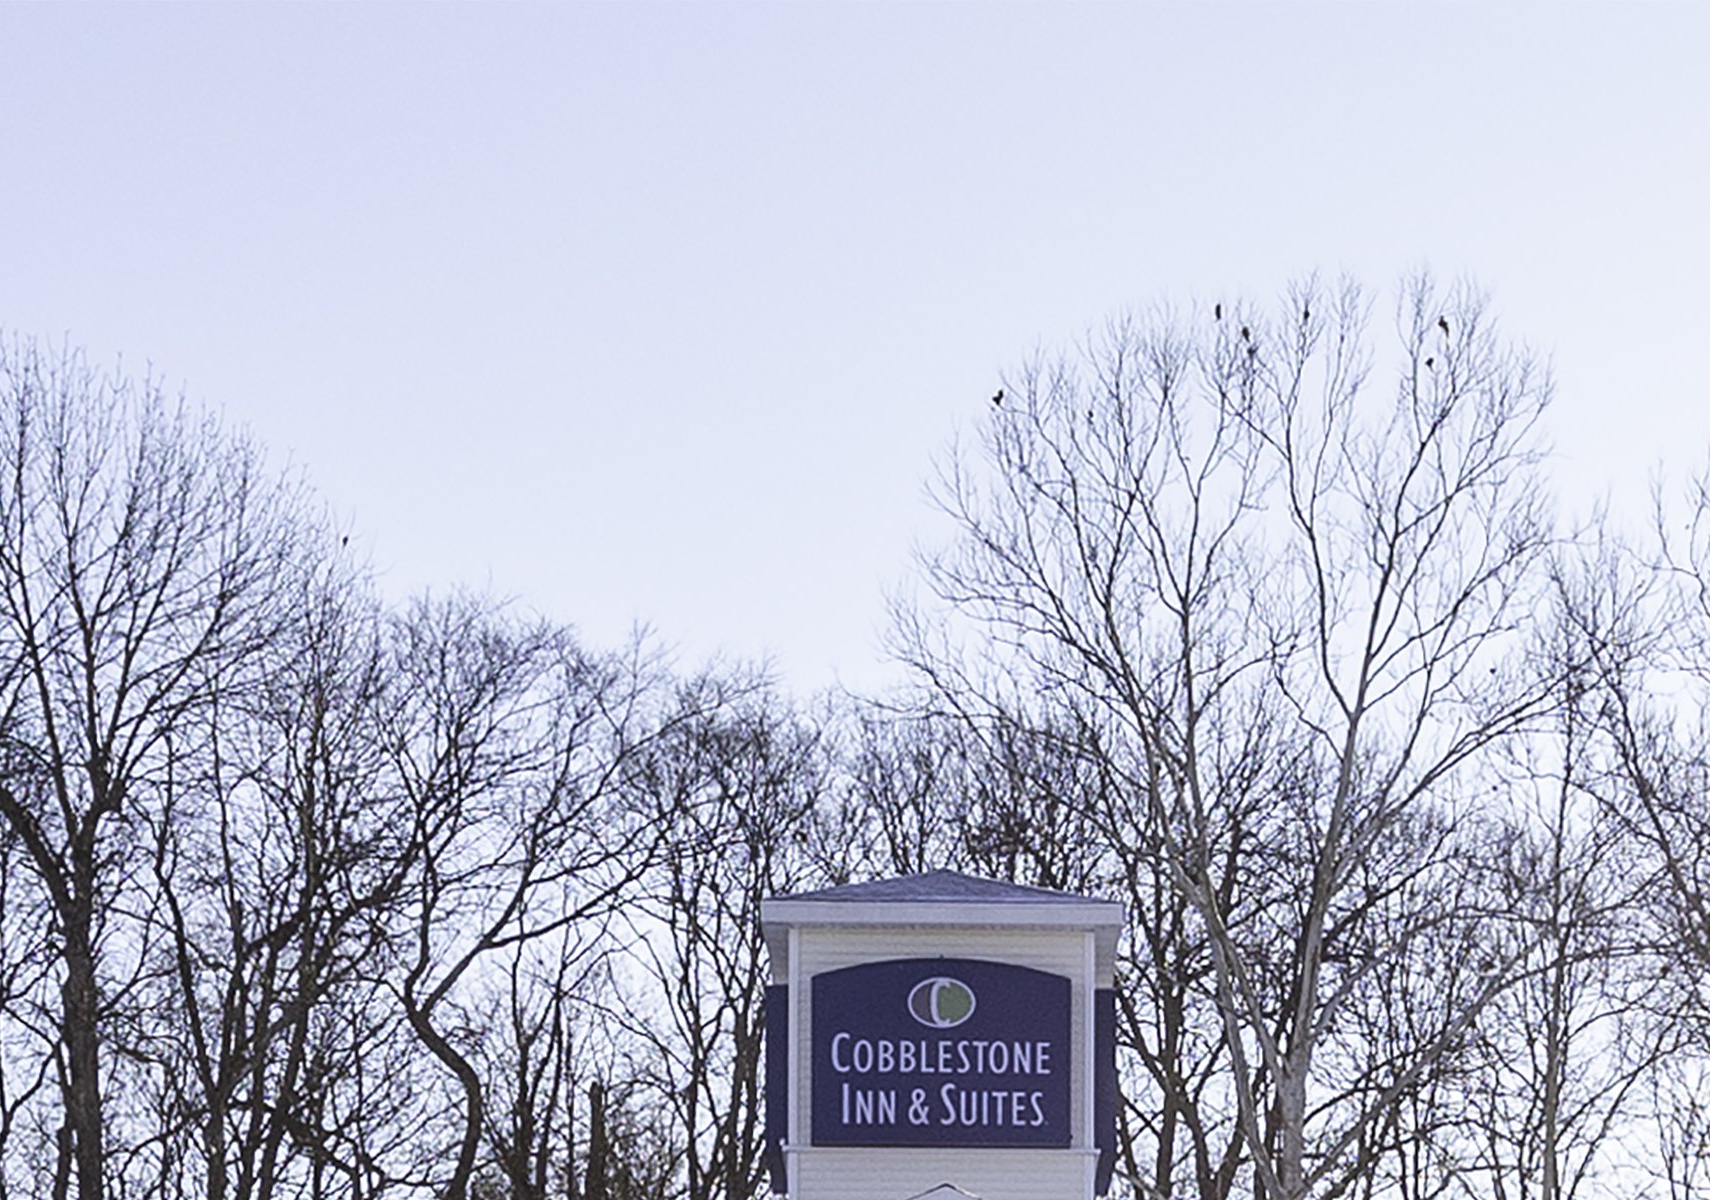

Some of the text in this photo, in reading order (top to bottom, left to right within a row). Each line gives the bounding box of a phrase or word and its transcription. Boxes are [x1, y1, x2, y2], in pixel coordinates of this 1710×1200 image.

[831, 1032, 1051, 1074] COBBLESTONE
[842, 1083, 1044, 1126] INN & SUITES
